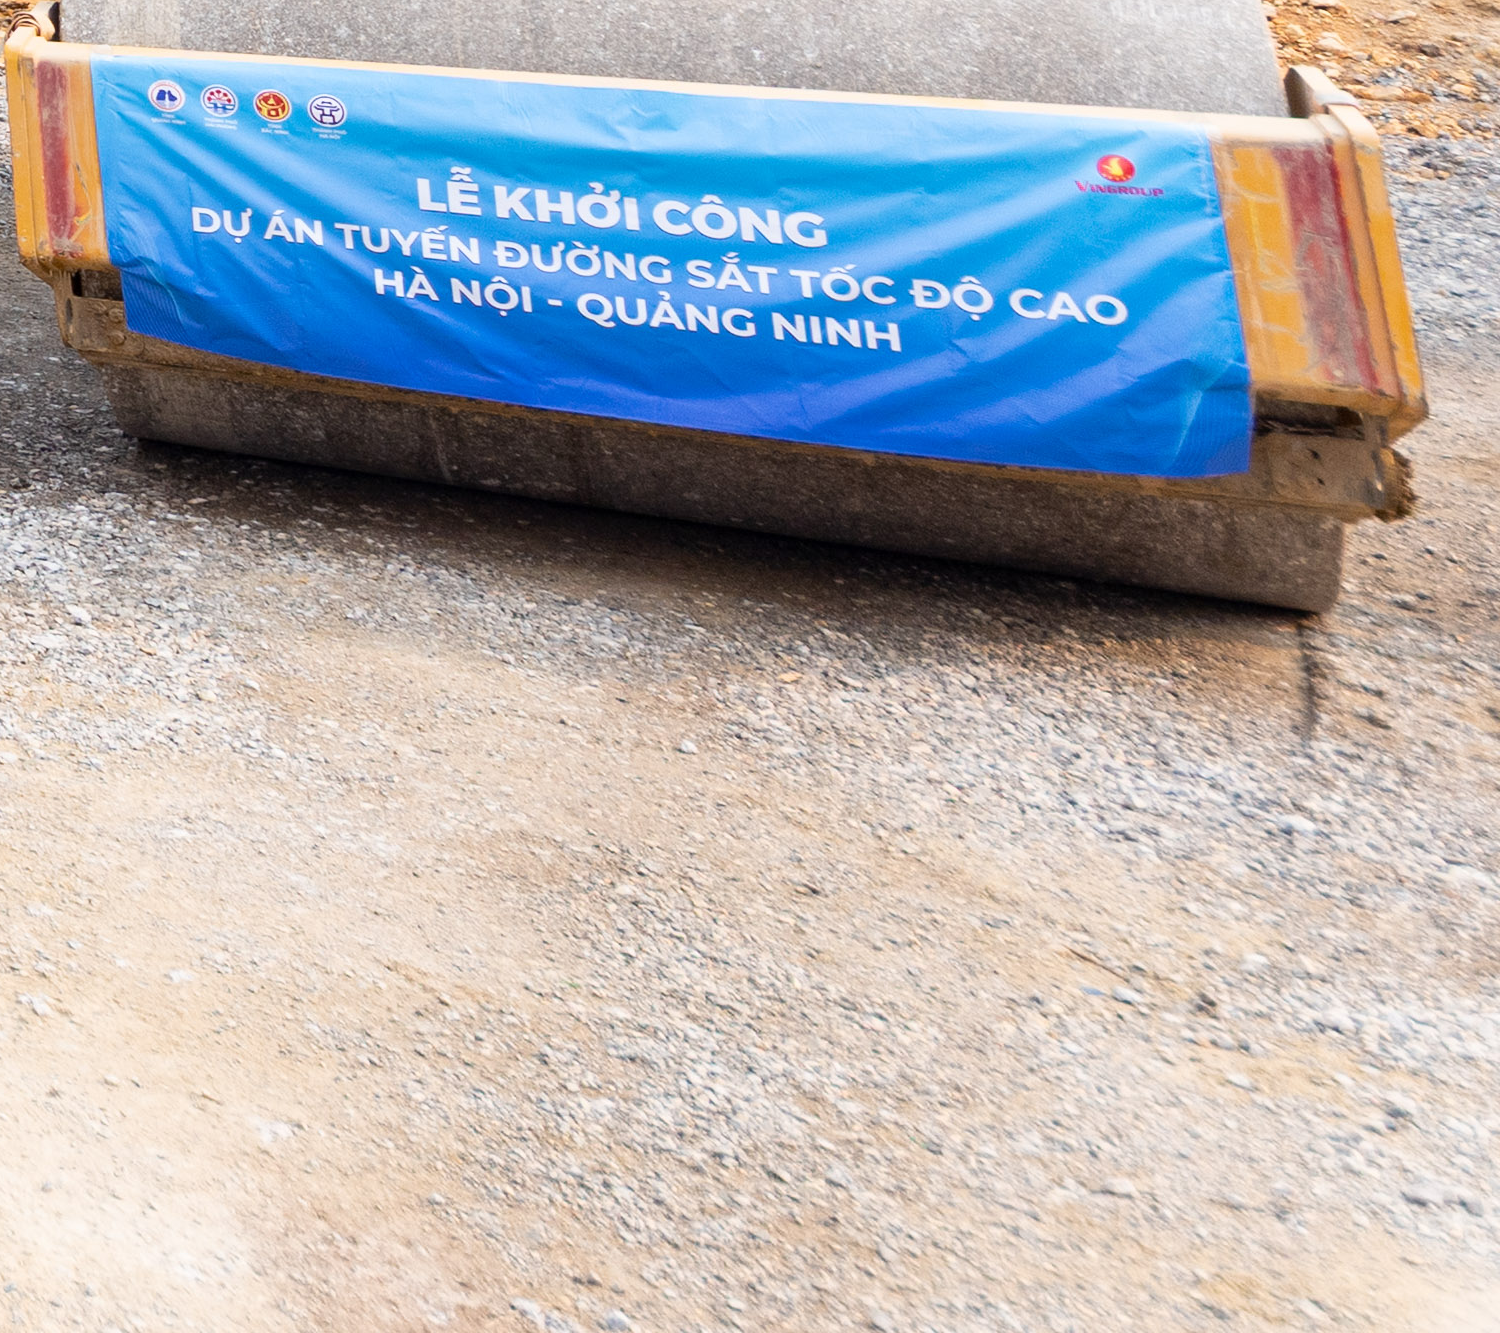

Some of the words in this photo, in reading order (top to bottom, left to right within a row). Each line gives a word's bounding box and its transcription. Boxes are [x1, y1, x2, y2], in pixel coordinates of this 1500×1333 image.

[416, 166, 482, 216] LỄ
[494, 181, 640, 232] KHỞI
[651, 194, 828, 248] CÔNG
[192, 207, 252, 244] DỰ
[263, 208, 324, 246] ÁN
[334, 223, 481, 265] TUYẾN
[492, 241, 673, 285] ĐƯỜNG
[686, 252, 779, 294] SẮT
[789, 264, 898, 306] TỐC
[910, 275, 995, 321] ĐỘ
[1009, 288, 1129, 326] CAO
[374, 265, 440, 302] HÀ
[451, 275, 533, 318] NỘI
[547, 299, 562, 307] -
[576, 290, 757, 339] QUẢNG
[772, 313, 903, 353] NINH
